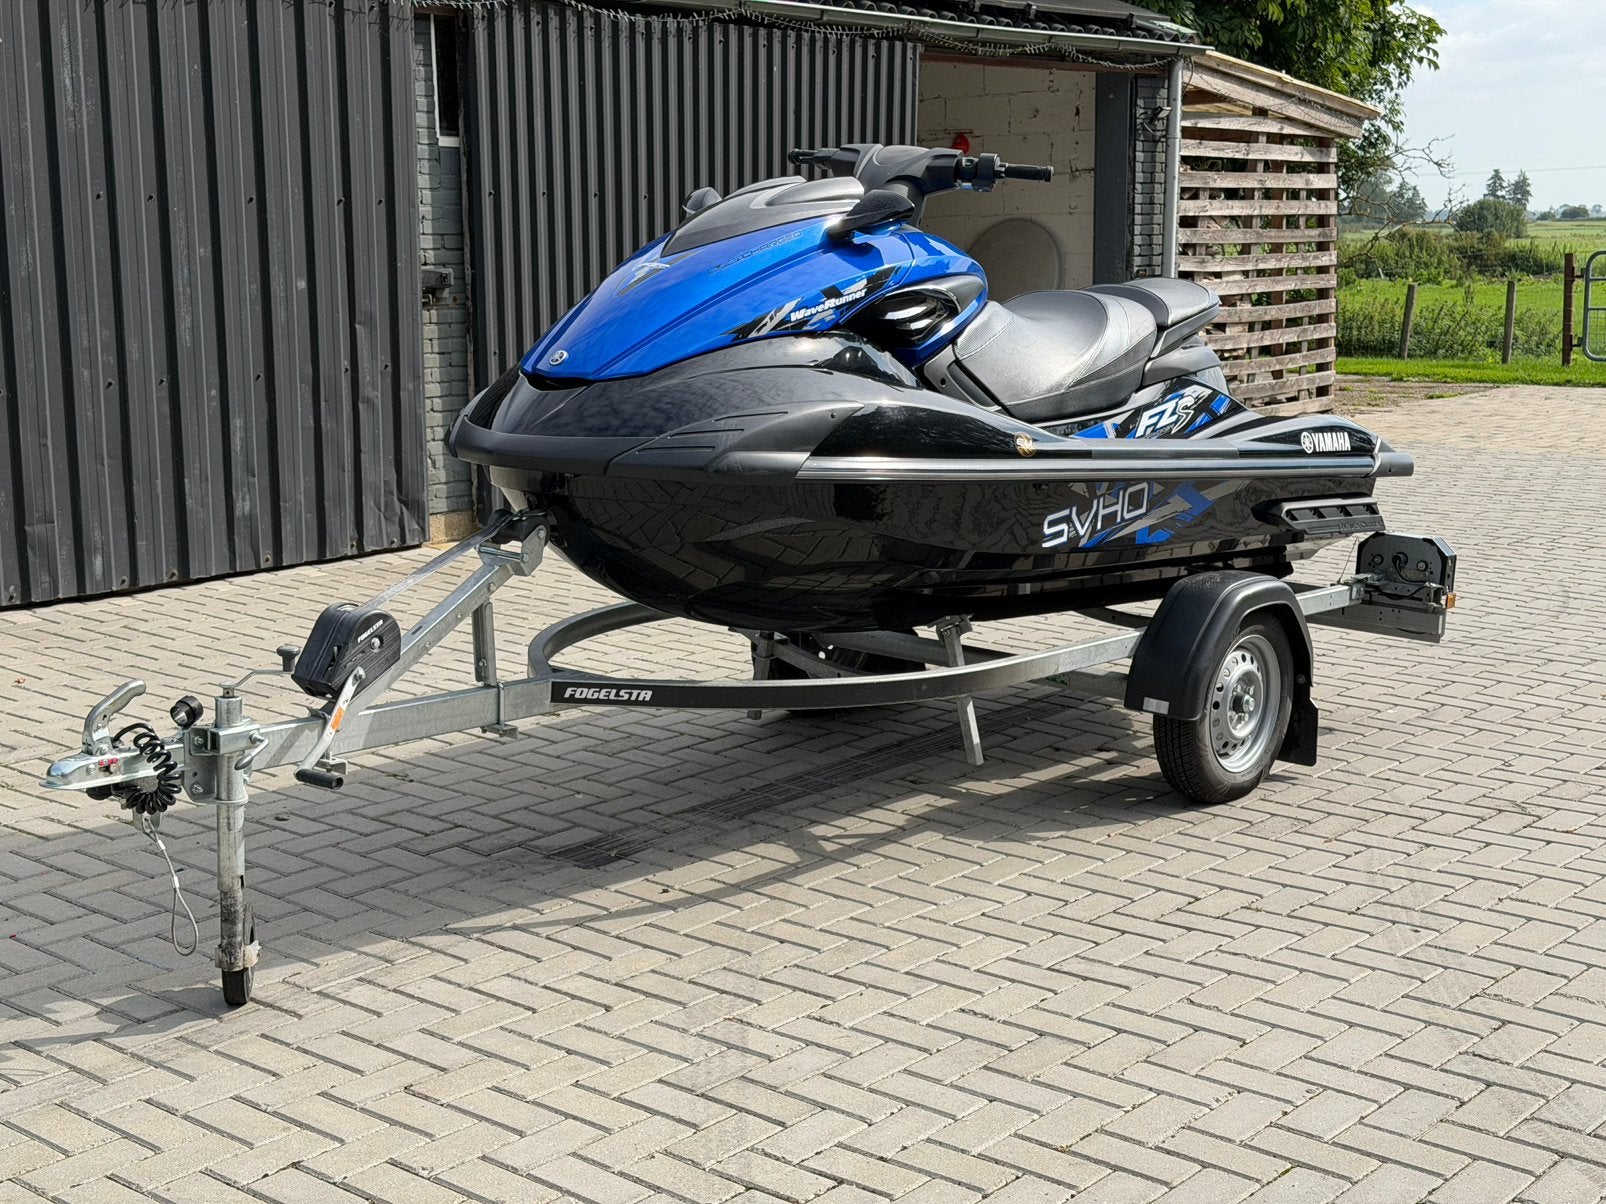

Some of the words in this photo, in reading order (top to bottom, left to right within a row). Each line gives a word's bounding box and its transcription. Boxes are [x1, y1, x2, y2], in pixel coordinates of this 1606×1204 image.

[789, 287, 868, 322] WaveRunner
[1311, 431, 1351, 452] YAMAHA
[1041, 481, 1149, 548] SVHO
[563, 687, 653, 702] FOGELSTA
